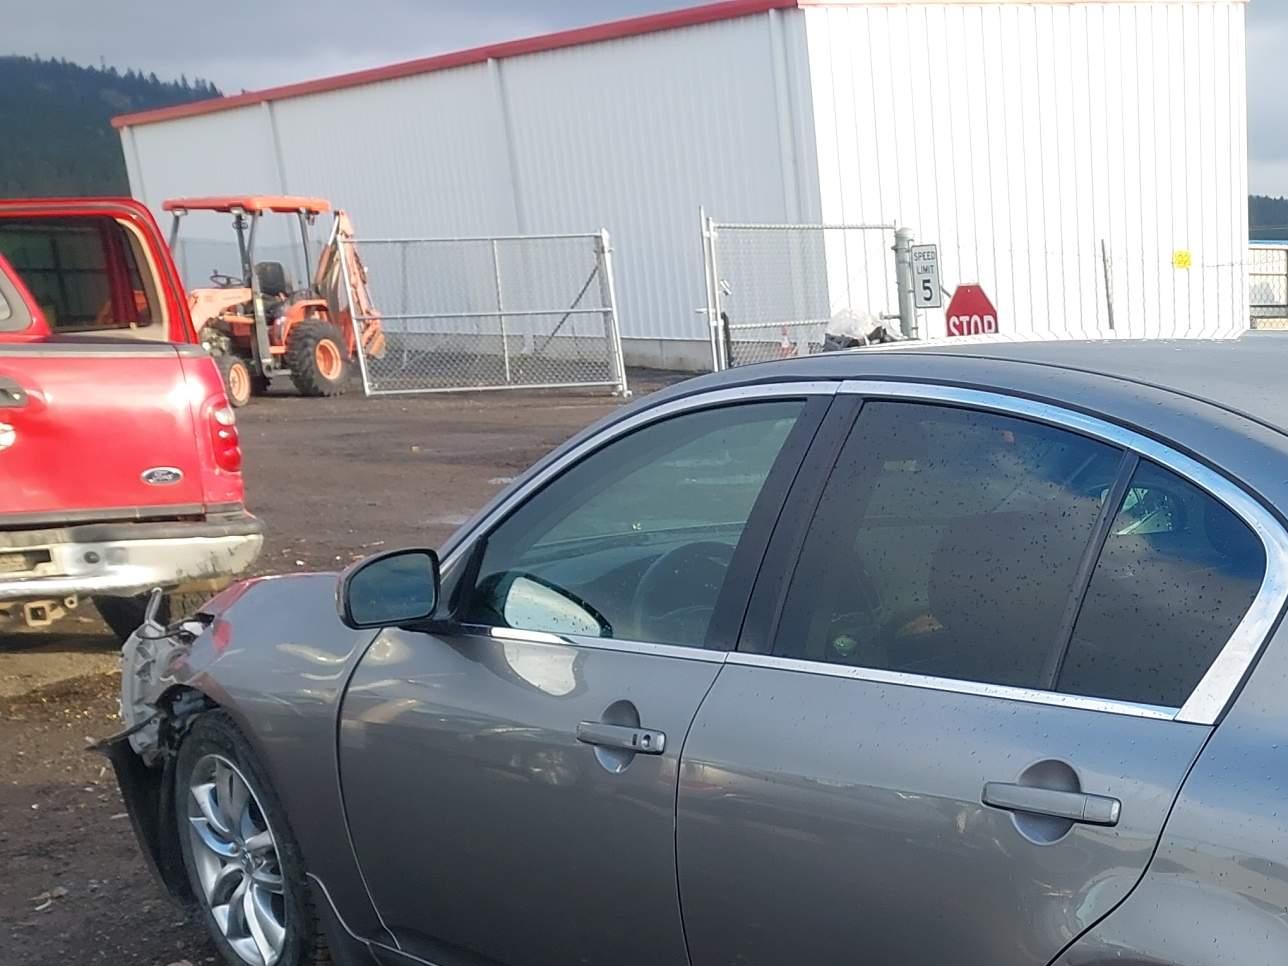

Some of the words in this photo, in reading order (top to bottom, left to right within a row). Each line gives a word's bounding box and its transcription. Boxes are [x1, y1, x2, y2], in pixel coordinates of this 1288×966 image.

[914, 251, 935, 261] SPEED
[917, 264, 935, 275] LIMIT
[922, 279, 933, 301] 5
[949, 314, 996, 336] STOP
